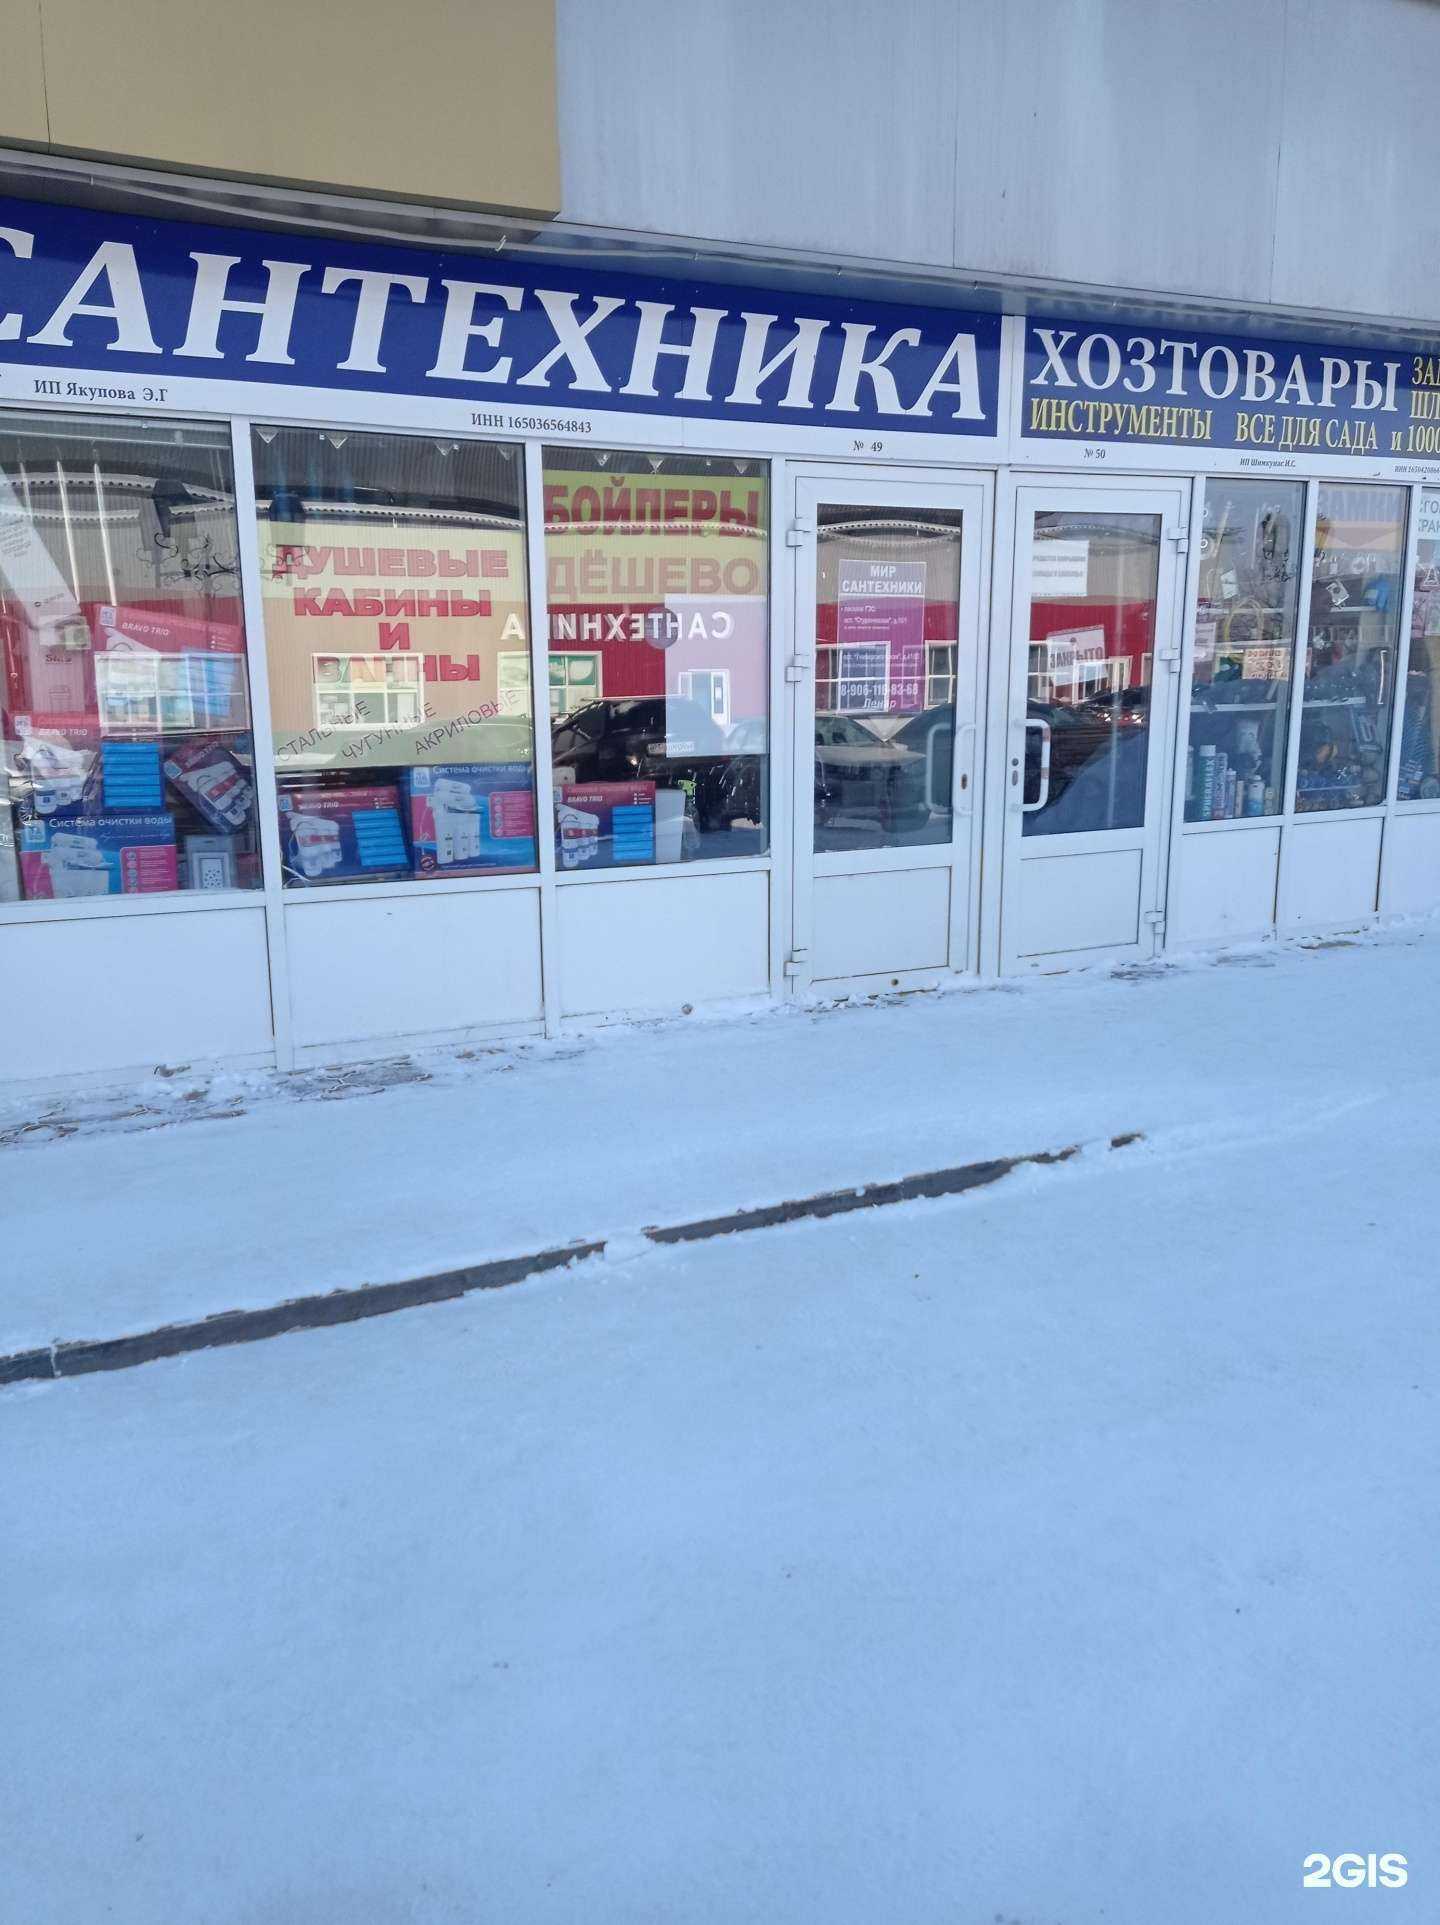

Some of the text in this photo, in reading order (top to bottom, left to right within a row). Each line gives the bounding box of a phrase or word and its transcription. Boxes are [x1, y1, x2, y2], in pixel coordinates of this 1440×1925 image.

[1030, 328, 1401, 412] ХОЗТОВАРЫ
[1412, 356, 1440, 386] ЗА
[34, 380, 168, 401] ИП Якупова Э.Г
[472, 413, 592, 433] ИНН 165036564843
[1029, 397, 1212, 440] ИНСТРУМЕНТЫ
[871, 441, 883, 452] 49
[1235, 412, 1379, 456] ВСЕ ДЛЯ САДА
[1096, 448, 1106, 459] 50
[543, 476, 760, 536] БОЙЛЕРЫ
[272, 543, 509, 580] ДУШЕВЫЕ
[547, 549, 759, 602] ДЁШЕВО
[870, 565, 897, 577] МИР
[293, 587, 492, 617] КАБИНЫ
[842, 580, 923, 594] САНТЕХНИКИ
[378, 622, 411, 650] И
[414, 688, 523, 756] АКРИЛОВЫЕ
[98, 818, 142, 827] очистки
